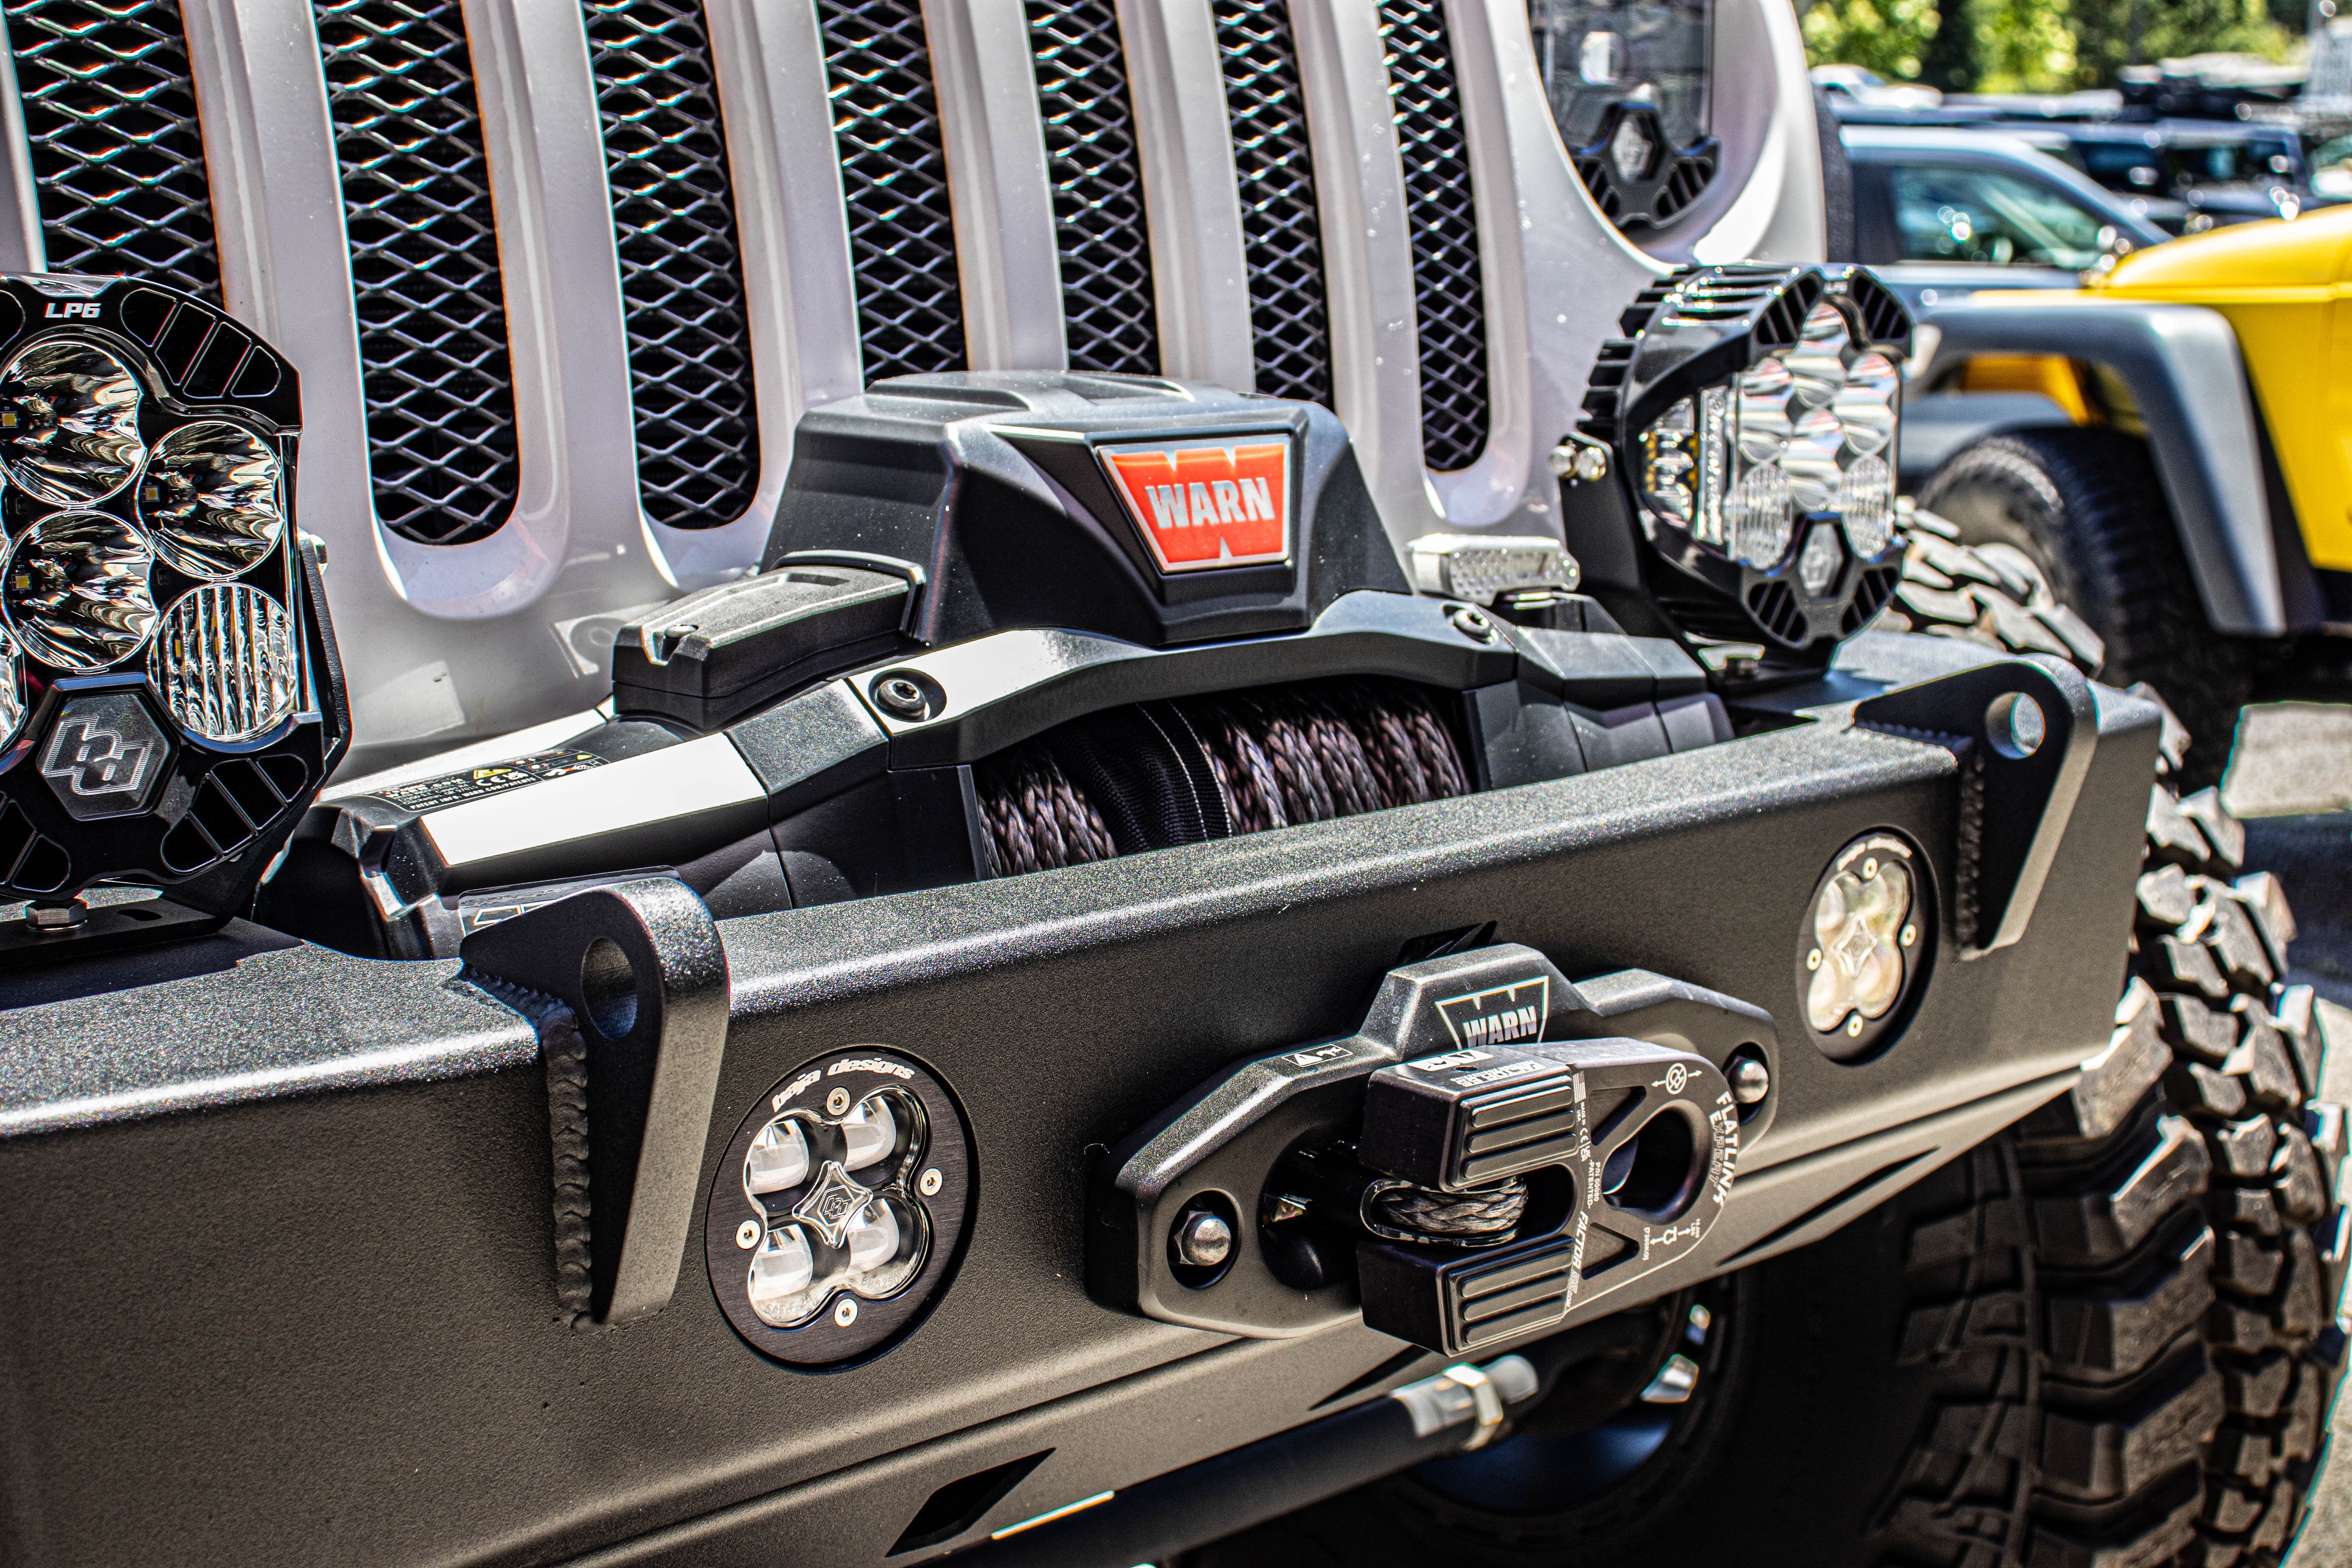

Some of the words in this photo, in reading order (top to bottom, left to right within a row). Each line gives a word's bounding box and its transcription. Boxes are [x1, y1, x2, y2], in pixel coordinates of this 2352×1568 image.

[45, 303, 102, 318] LP6
[1145, 477, 1275, 528] WARN
[410, 800, 439, 810] PATENT
[1462, 1005, 1537, 1049] WARN
[772, 1070, 821, 1112] baja
[827, 1058, 915, 1079] designs
[1709, 1110, 1725, 1187] EXPERT
[1713, 1091, 1738, 1207] FLATLINK
